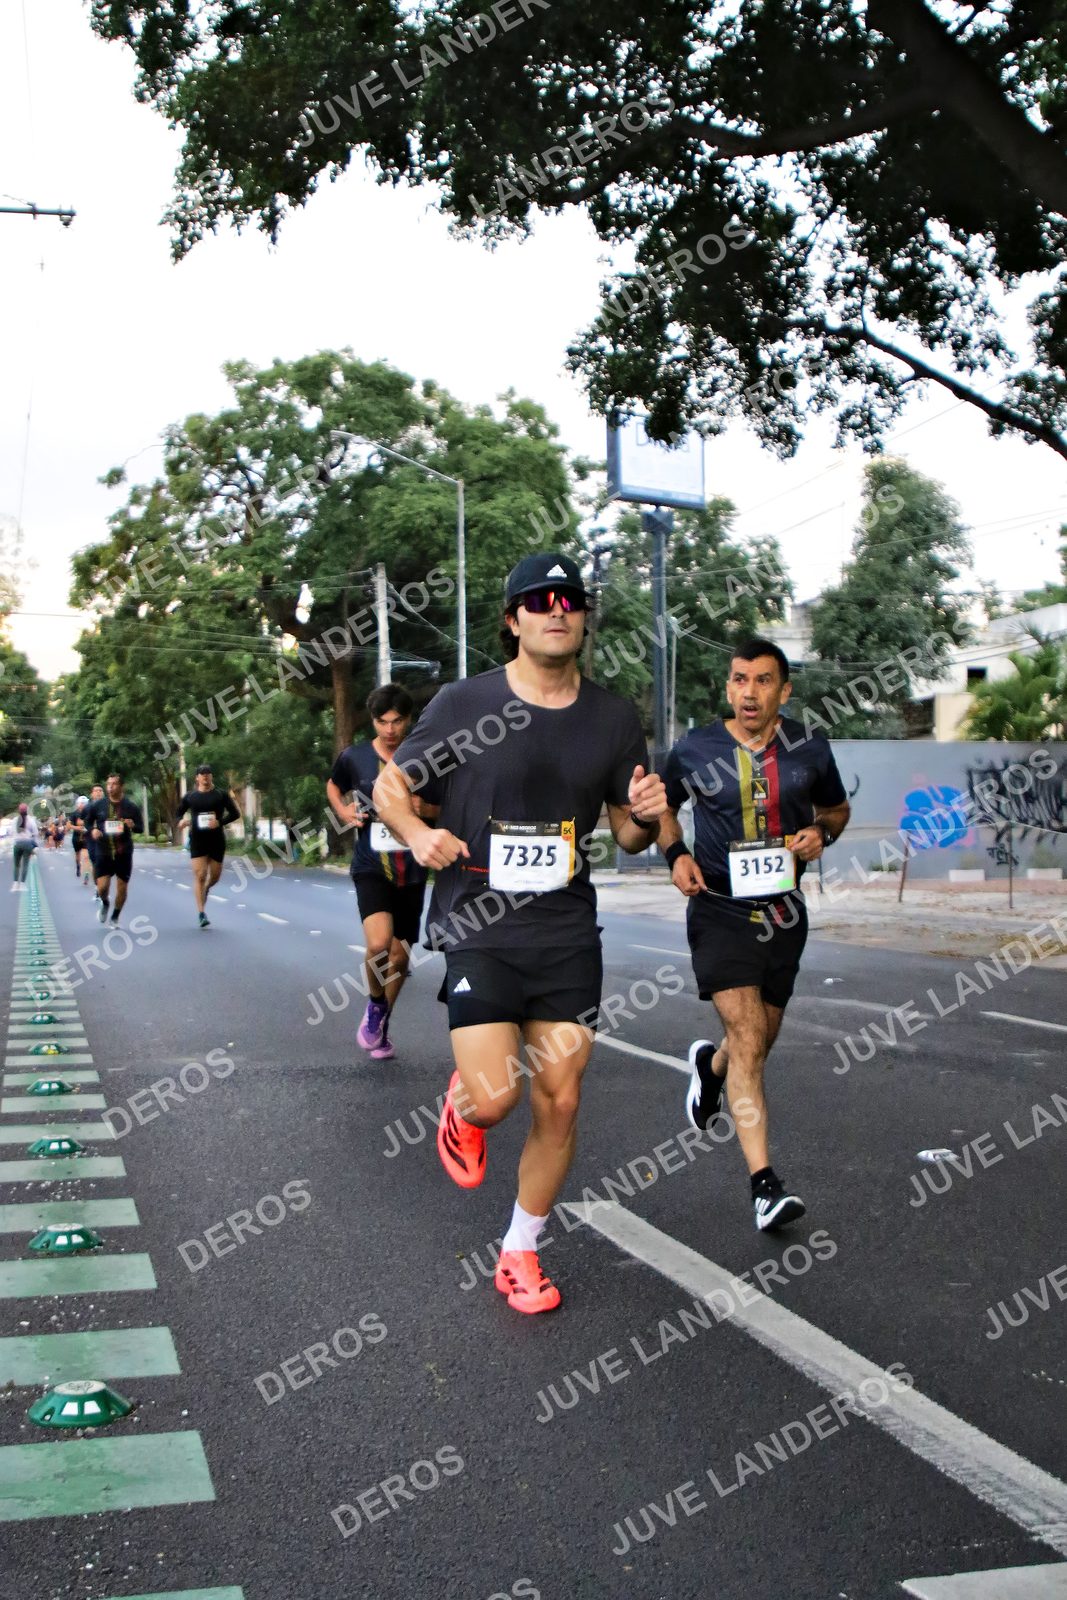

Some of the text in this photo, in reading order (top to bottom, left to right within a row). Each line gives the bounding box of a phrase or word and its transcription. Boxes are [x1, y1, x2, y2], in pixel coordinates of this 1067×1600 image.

[563, 827, 573, 835] 5K
[503, 844, 557, 867] 7325
[740, 855, 785, 877] 3152
